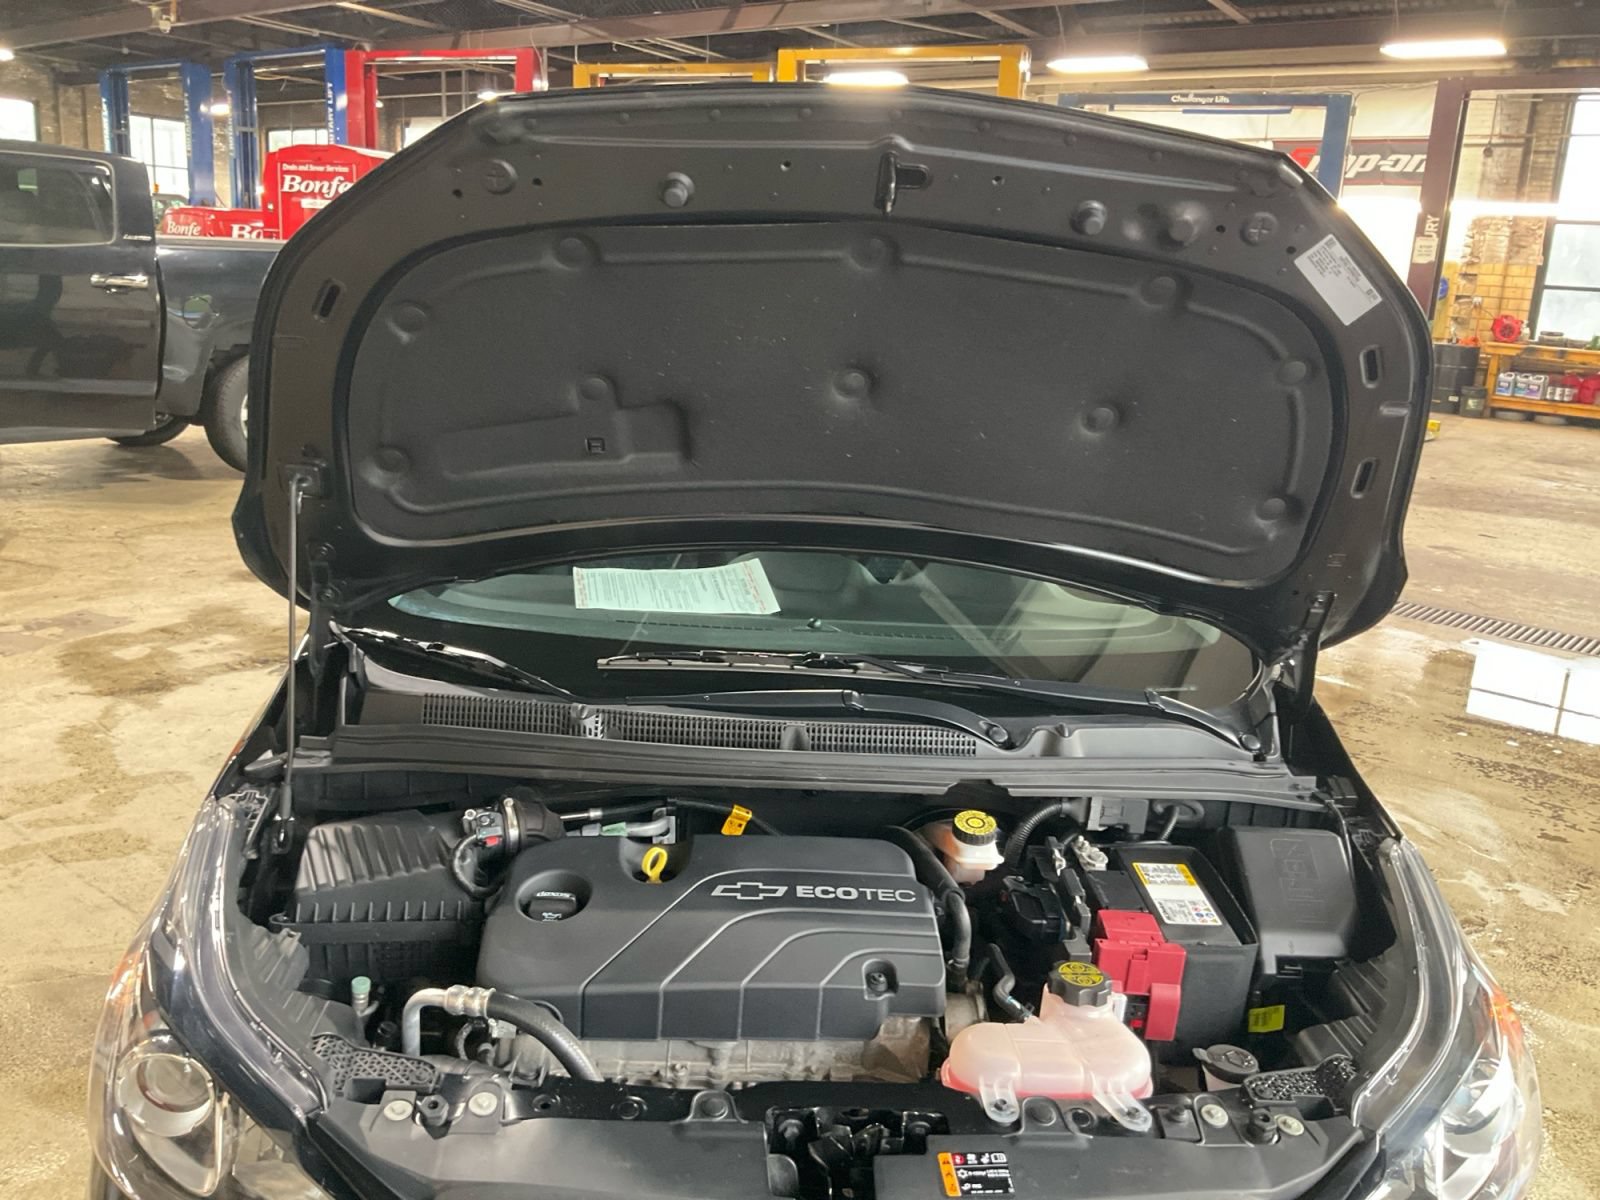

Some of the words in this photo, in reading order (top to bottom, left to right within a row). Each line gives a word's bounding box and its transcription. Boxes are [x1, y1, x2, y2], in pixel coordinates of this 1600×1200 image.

[1171, 93, 1213, 104] Challenger
[1215, 95, 1230, 103] Lifts
[167, 220, 201, 236] Bonfe
[796, 885, 917, 902] ECOTEC
